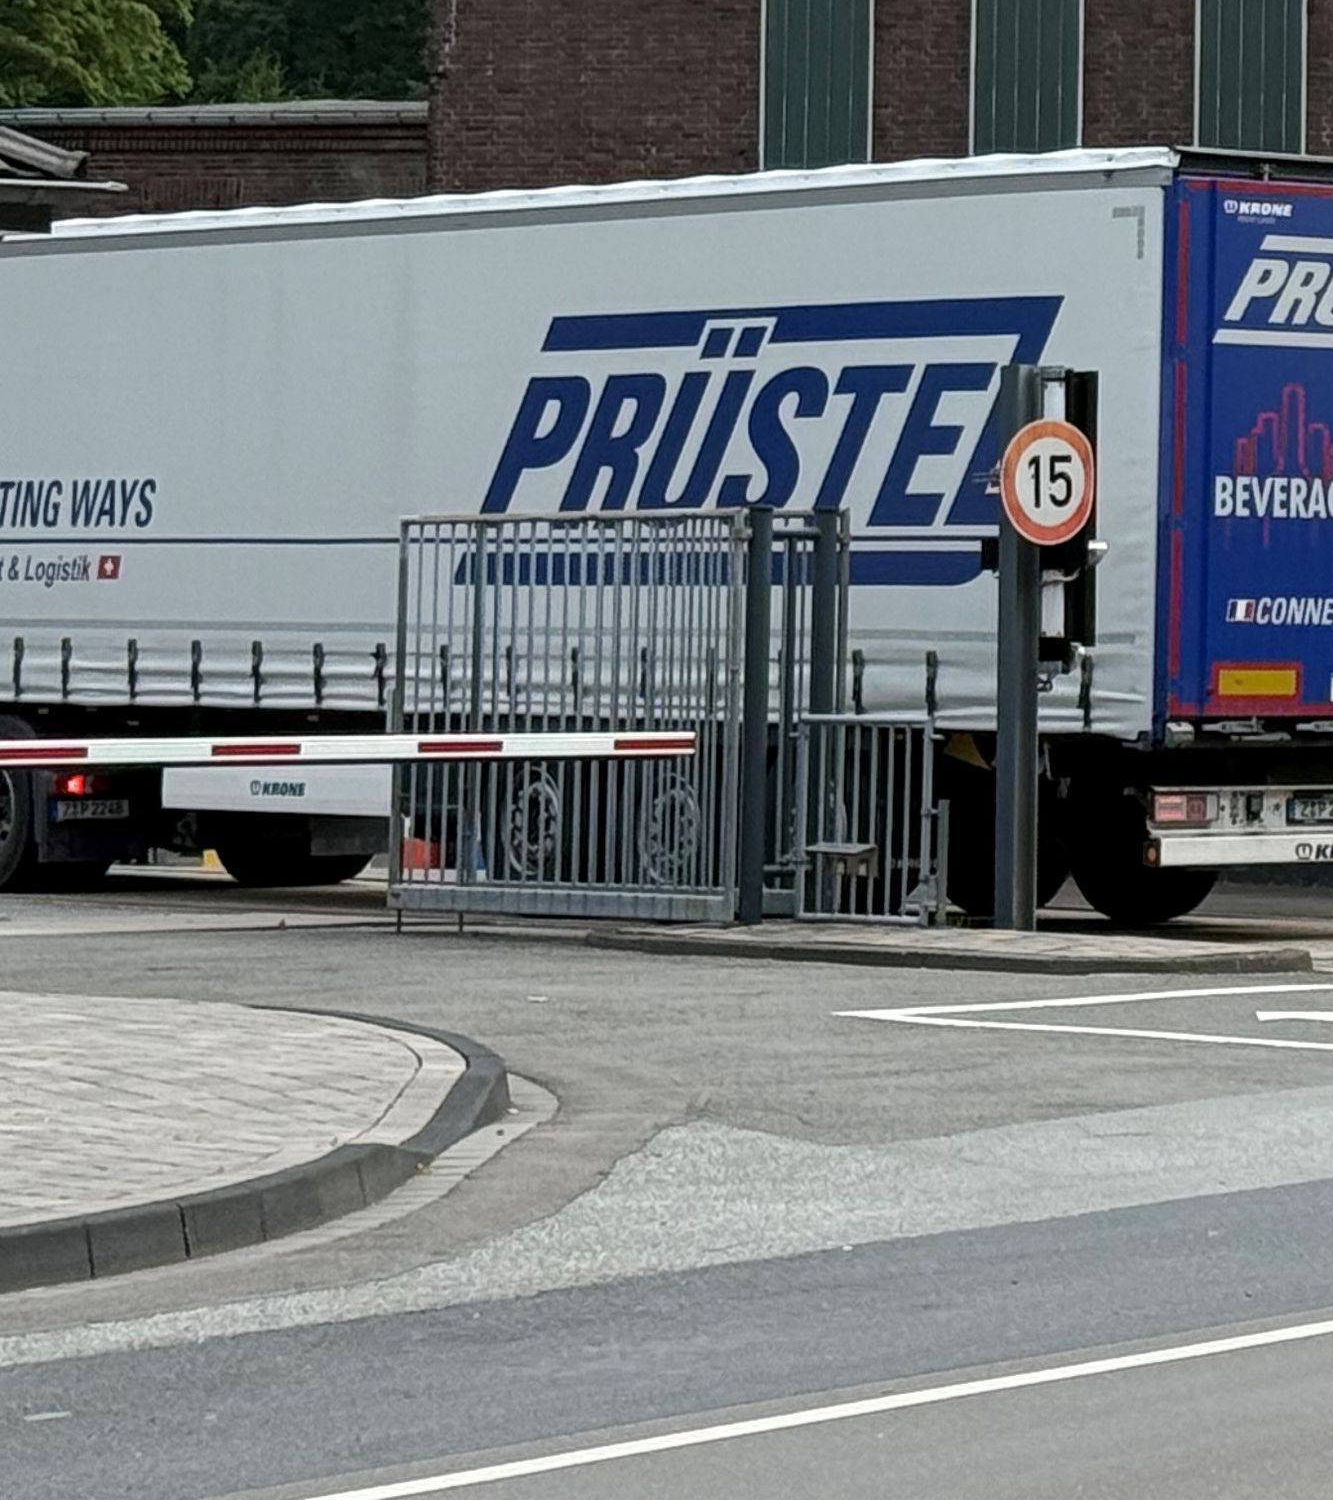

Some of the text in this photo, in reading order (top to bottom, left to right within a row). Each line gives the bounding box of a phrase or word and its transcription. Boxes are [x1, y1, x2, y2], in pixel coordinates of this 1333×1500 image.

[1239, 201, 1293, 217] KRONE
[1028, 455, 1072, 509] 15
[71, 479, 156, 528] WAYS
[7, 555, 19, 581] &
[24, 554, 91, 588] Logistik
